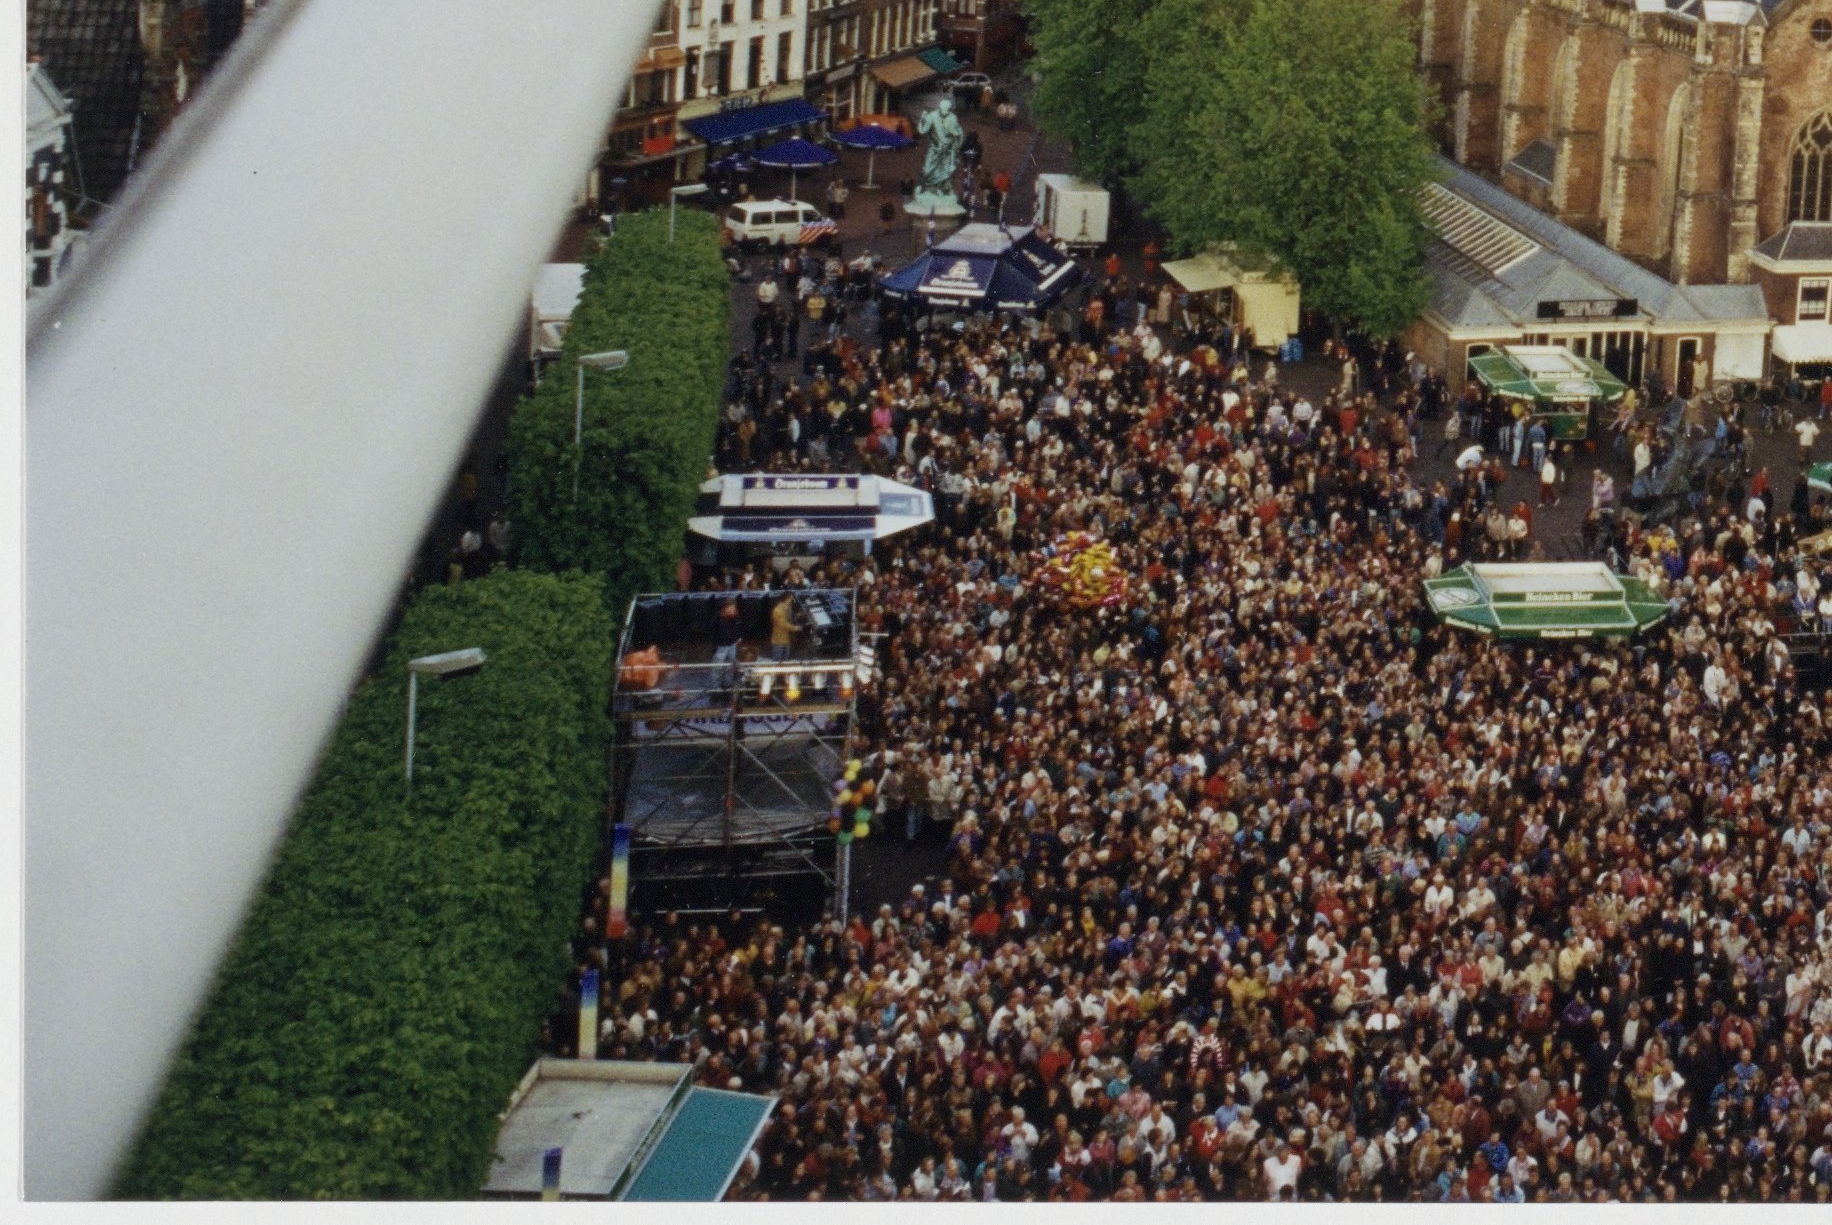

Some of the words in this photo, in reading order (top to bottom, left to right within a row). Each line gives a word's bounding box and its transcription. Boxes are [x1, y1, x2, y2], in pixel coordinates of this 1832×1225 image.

[774, 478, 829, 490] Oranjeboom
[1525, 592, 1571, 602] Heineken
[1573, 592, 1594, 601] Bier
